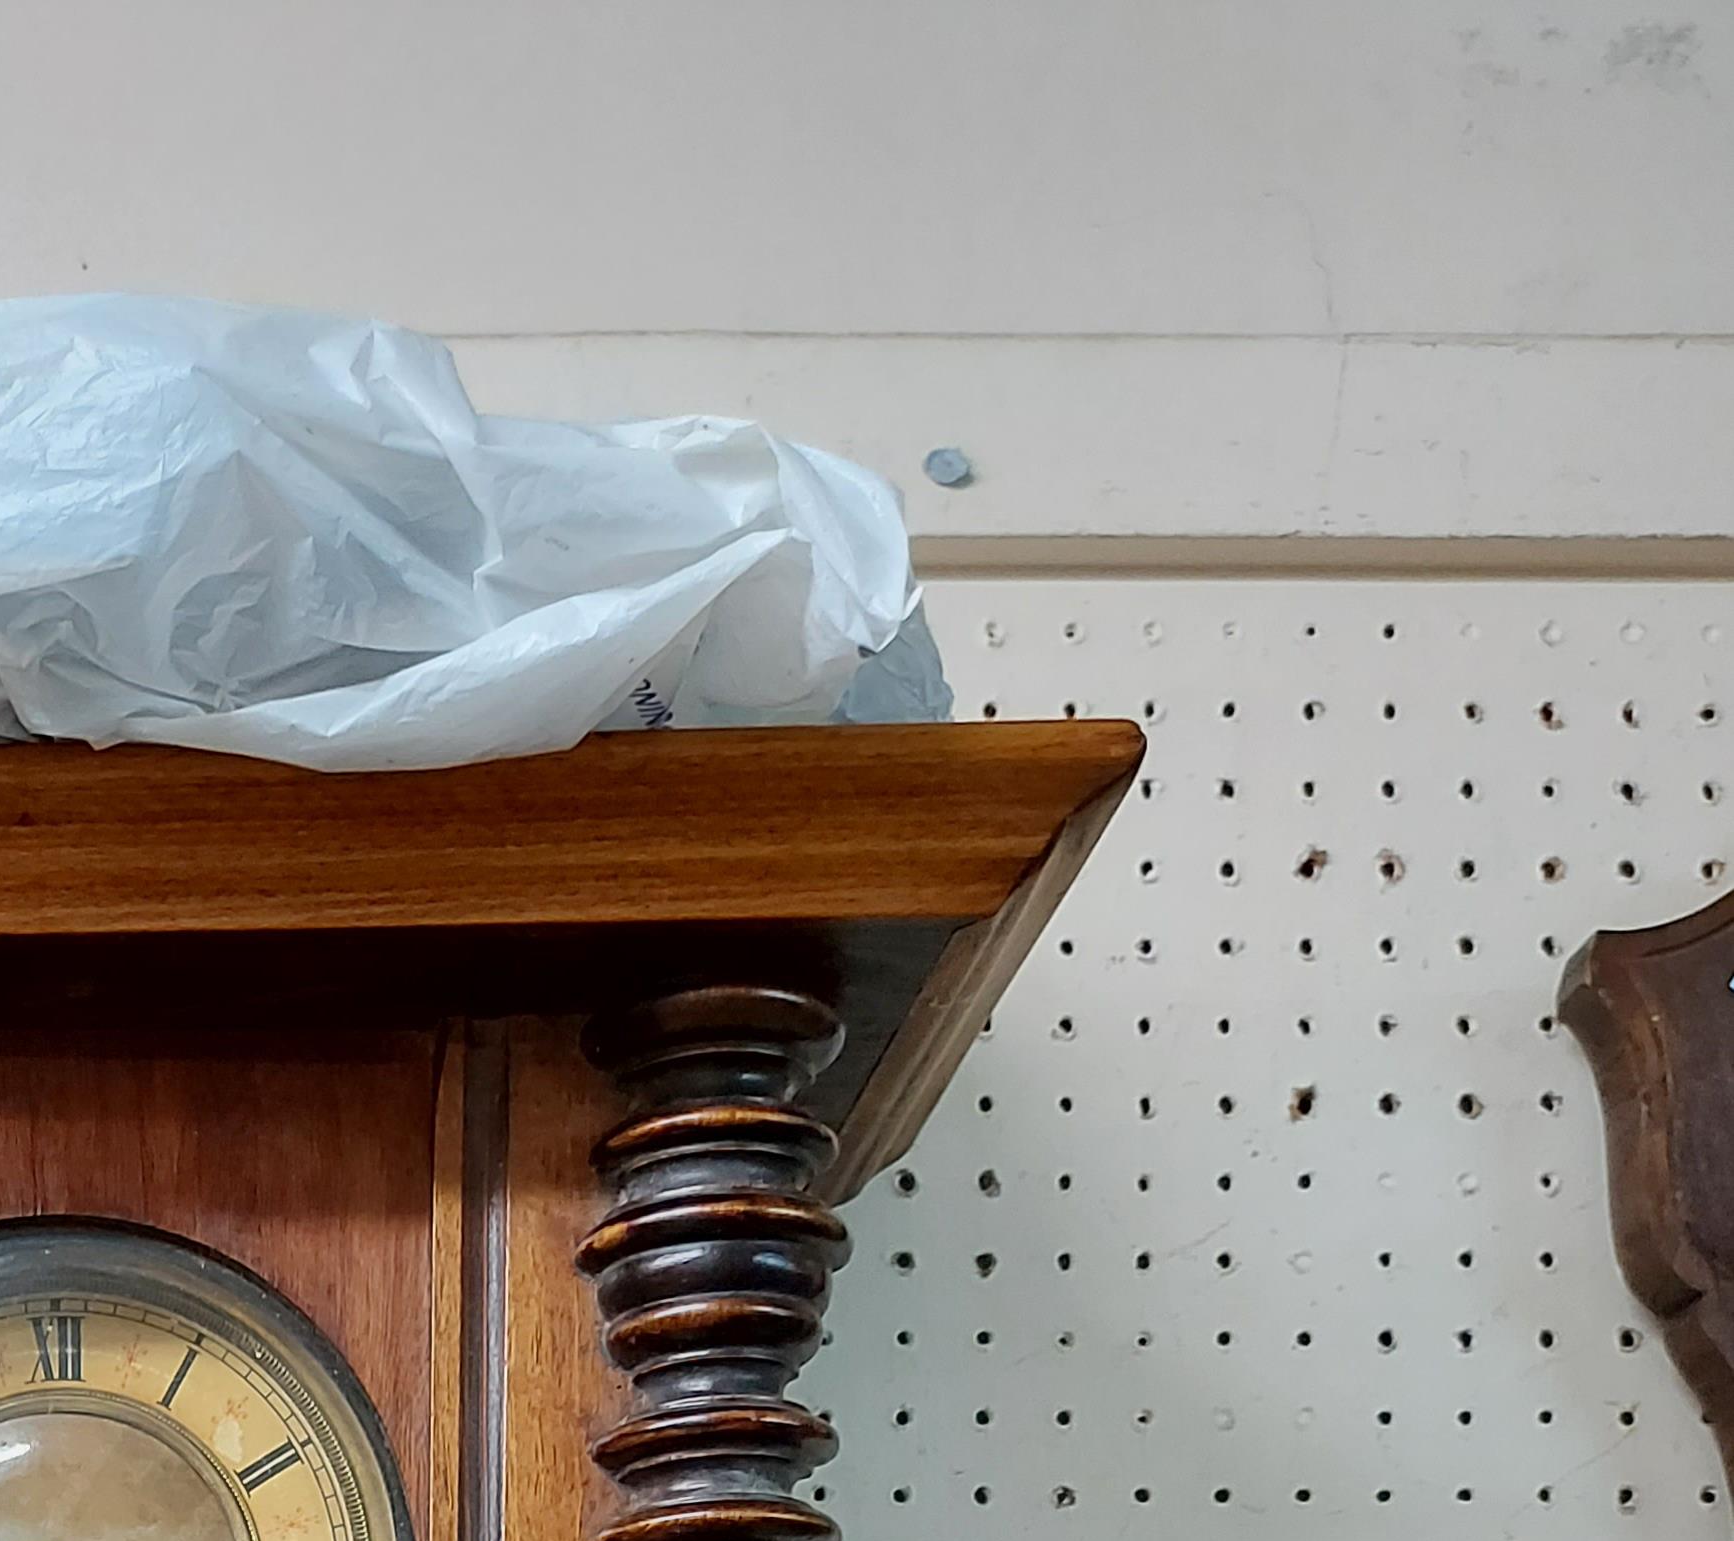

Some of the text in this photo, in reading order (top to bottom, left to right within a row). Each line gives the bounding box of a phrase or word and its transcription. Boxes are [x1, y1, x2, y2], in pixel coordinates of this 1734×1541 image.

[27, 1316, 86, 1385] XII
[156, 1344, 200, 1411] I
[236, 1436, 305, 1498] II
